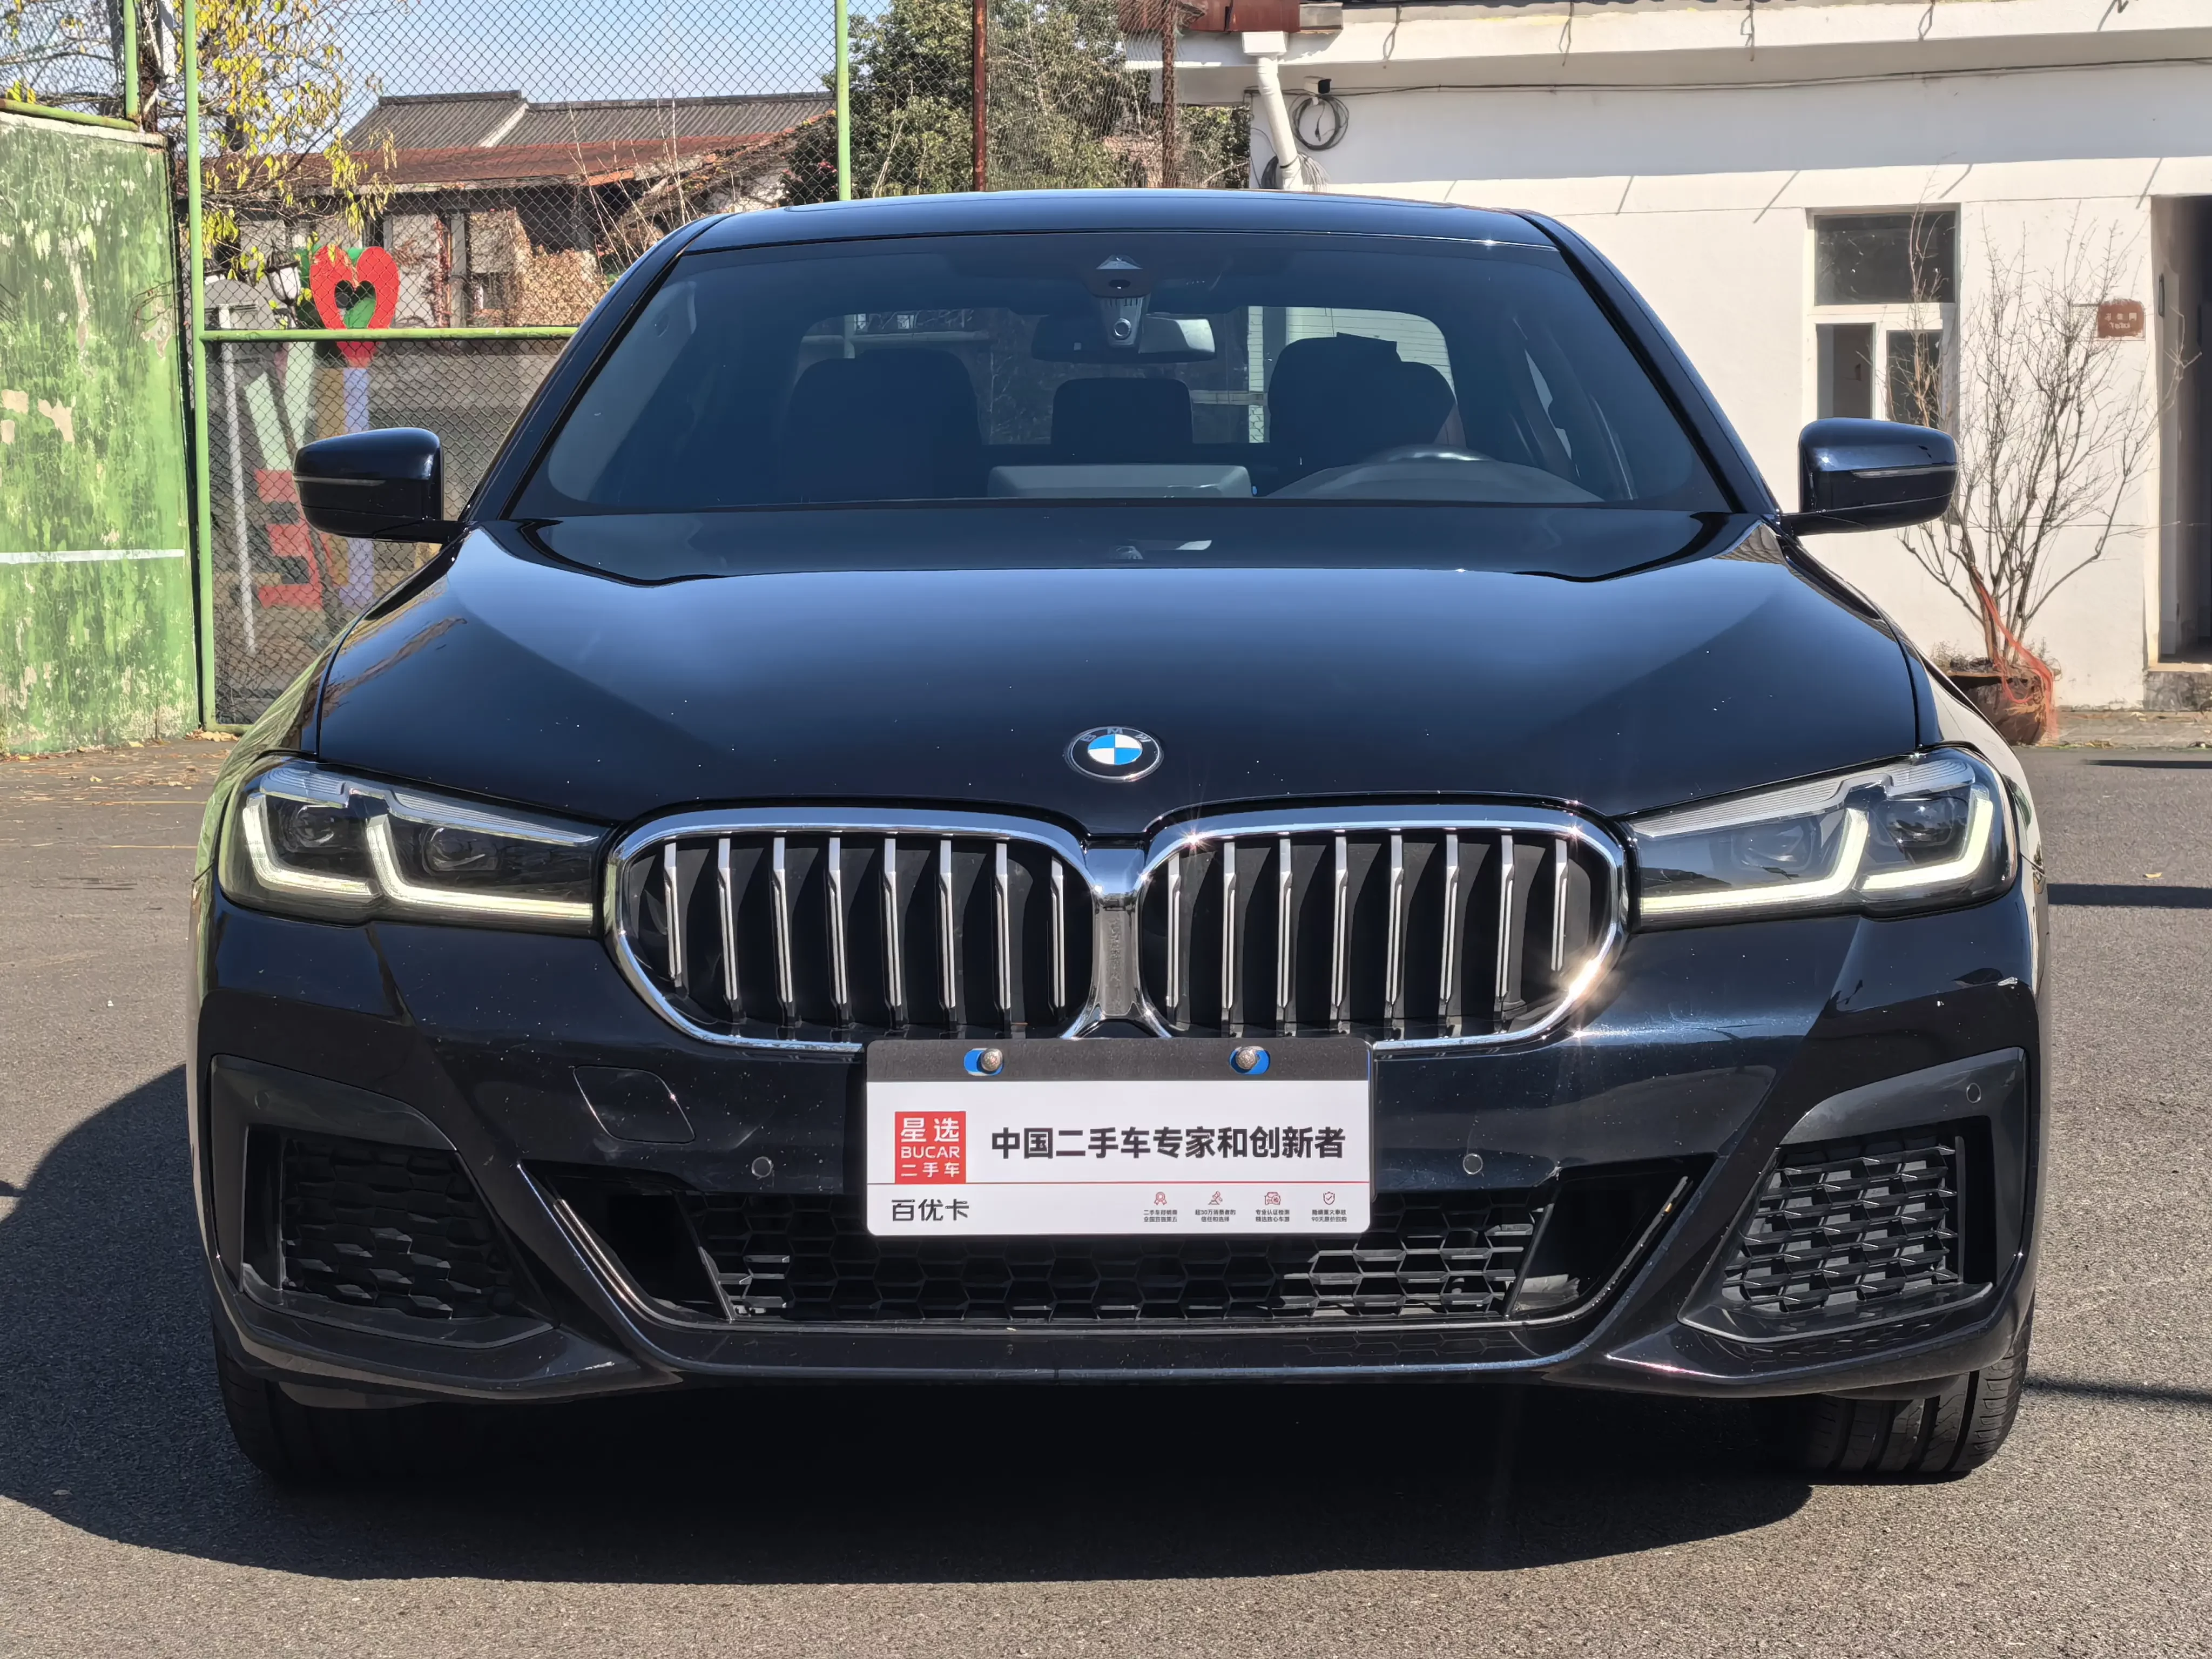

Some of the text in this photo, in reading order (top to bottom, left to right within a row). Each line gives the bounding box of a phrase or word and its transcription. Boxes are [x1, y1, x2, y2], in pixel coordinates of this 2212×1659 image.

[1080, 727, 1151, 743] BMW
[900, 1117, 960, 1143] 星选
[901, 1145, 960, 1159] BUCAR
[992, 1125, 1346, 1159] 中国二手车专家和创新者
[900, 1162, 960, 1178] 二手车
[891, 1198, 970, 1222] 百优卡
